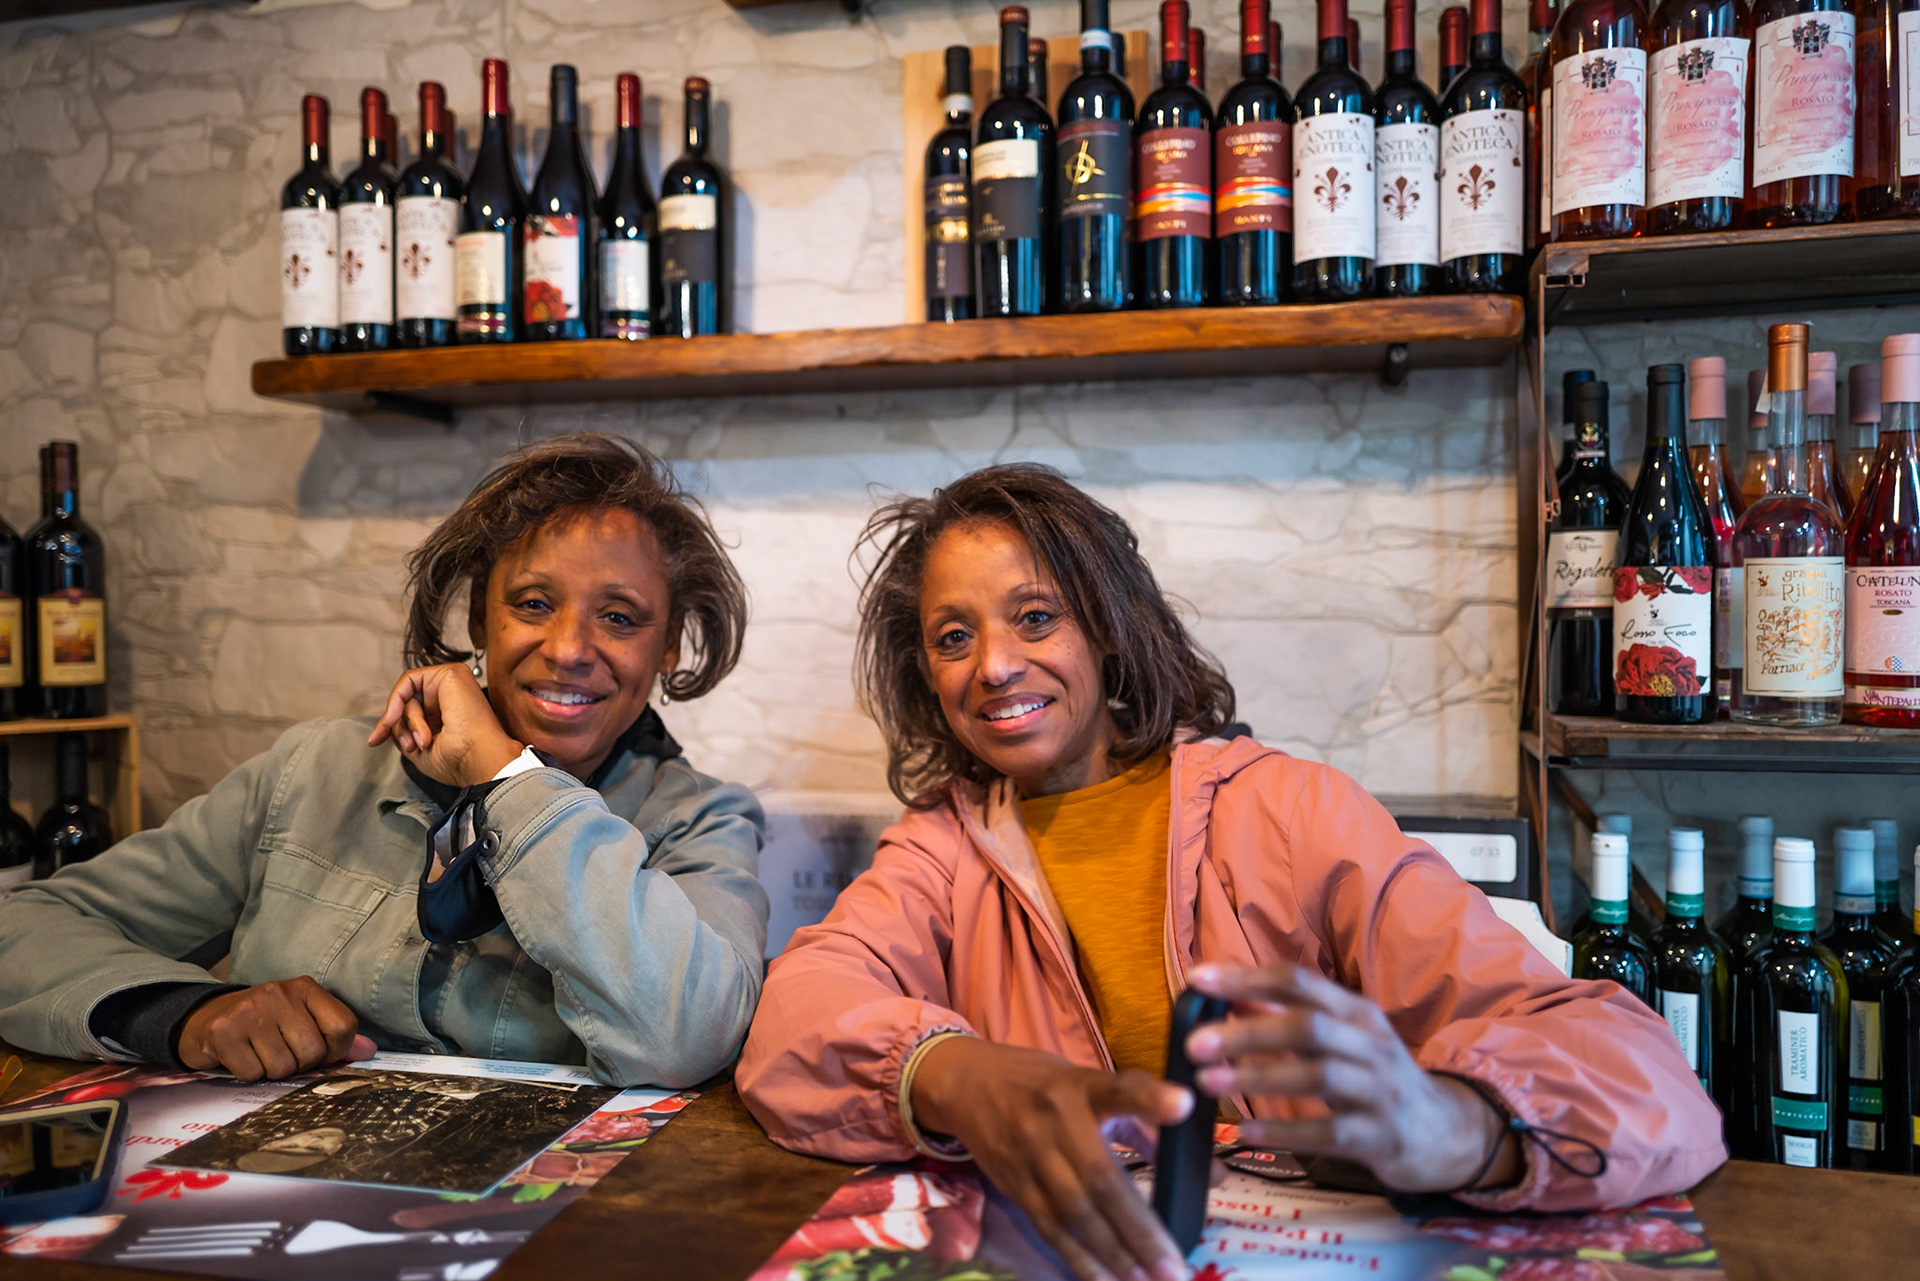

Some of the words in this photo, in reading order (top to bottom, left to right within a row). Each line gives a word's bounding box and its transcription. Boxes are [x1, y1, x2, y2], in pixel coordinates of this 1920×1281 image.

[1790, 1029, 1799, 1077] TRAMINER
[1798, 1026, 1808, 1081] AROMATICO
[1242, 1241, 1380, 1272] Enoteca
